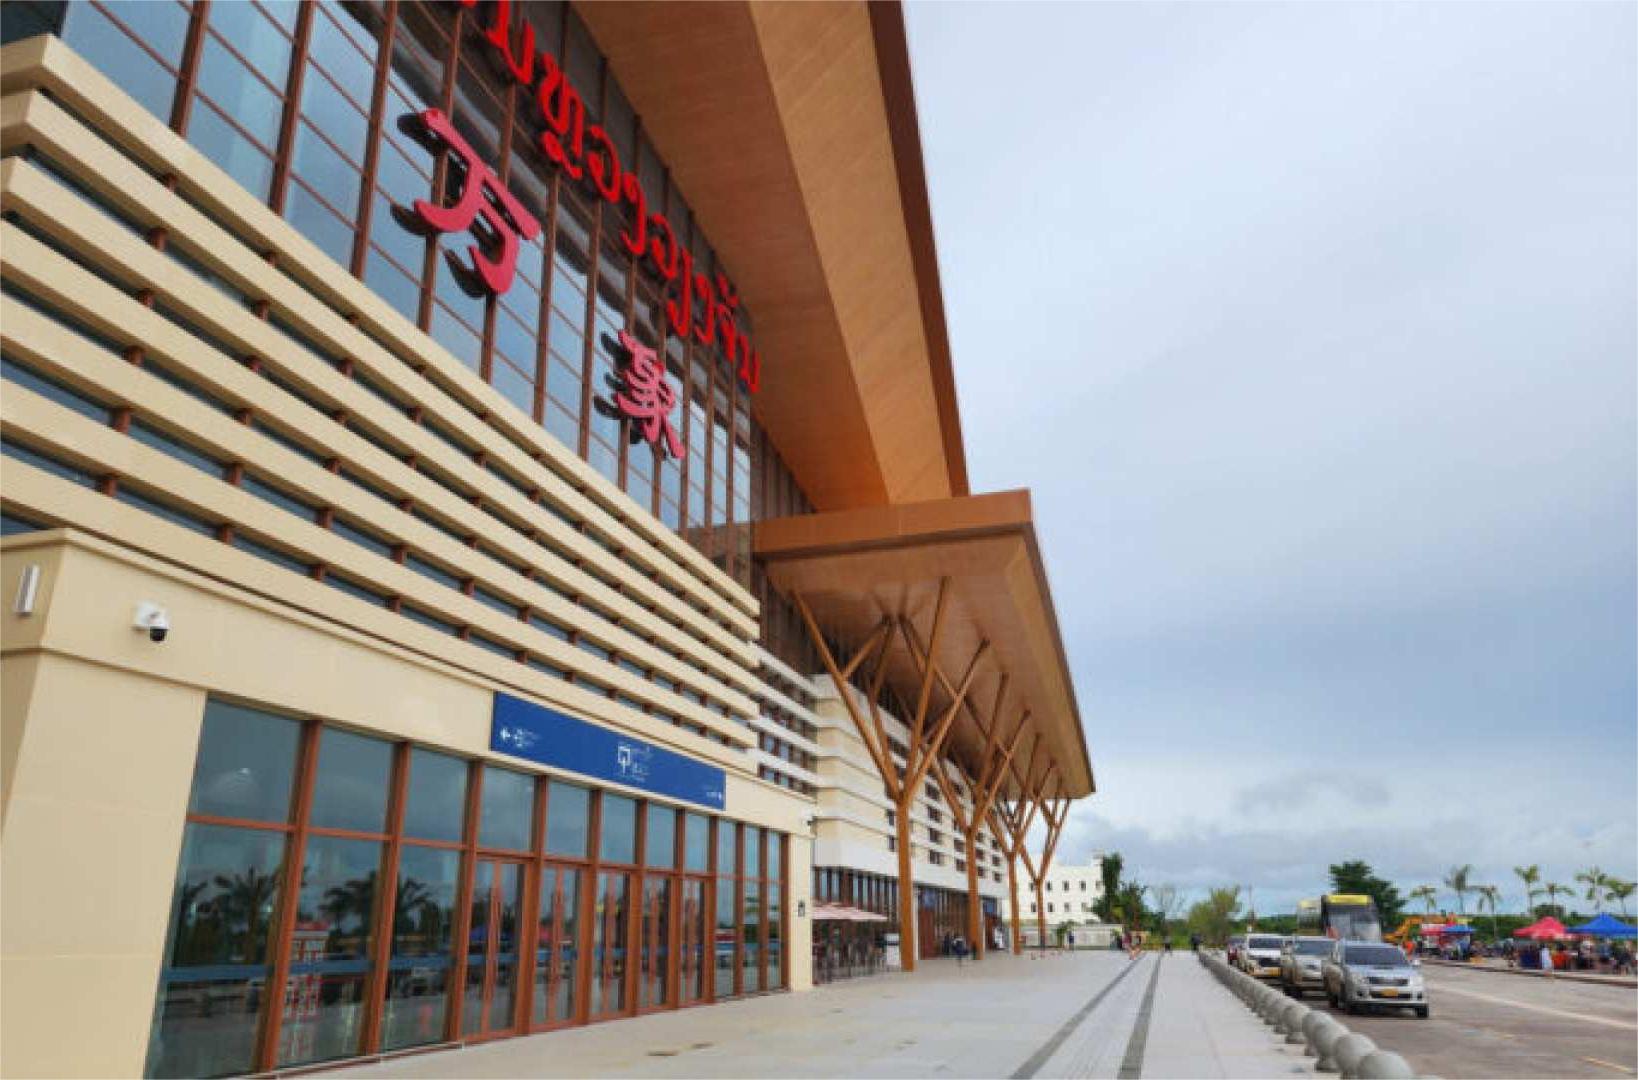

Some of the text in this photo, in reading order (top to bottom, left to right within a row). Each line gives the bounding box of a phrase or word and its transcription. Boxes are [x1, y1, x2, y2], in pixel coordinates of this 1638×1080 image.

[414, 108, 686, 458] 万象
[461, 0, 760, 393] ນຫຼວງວຽງຈັນ
